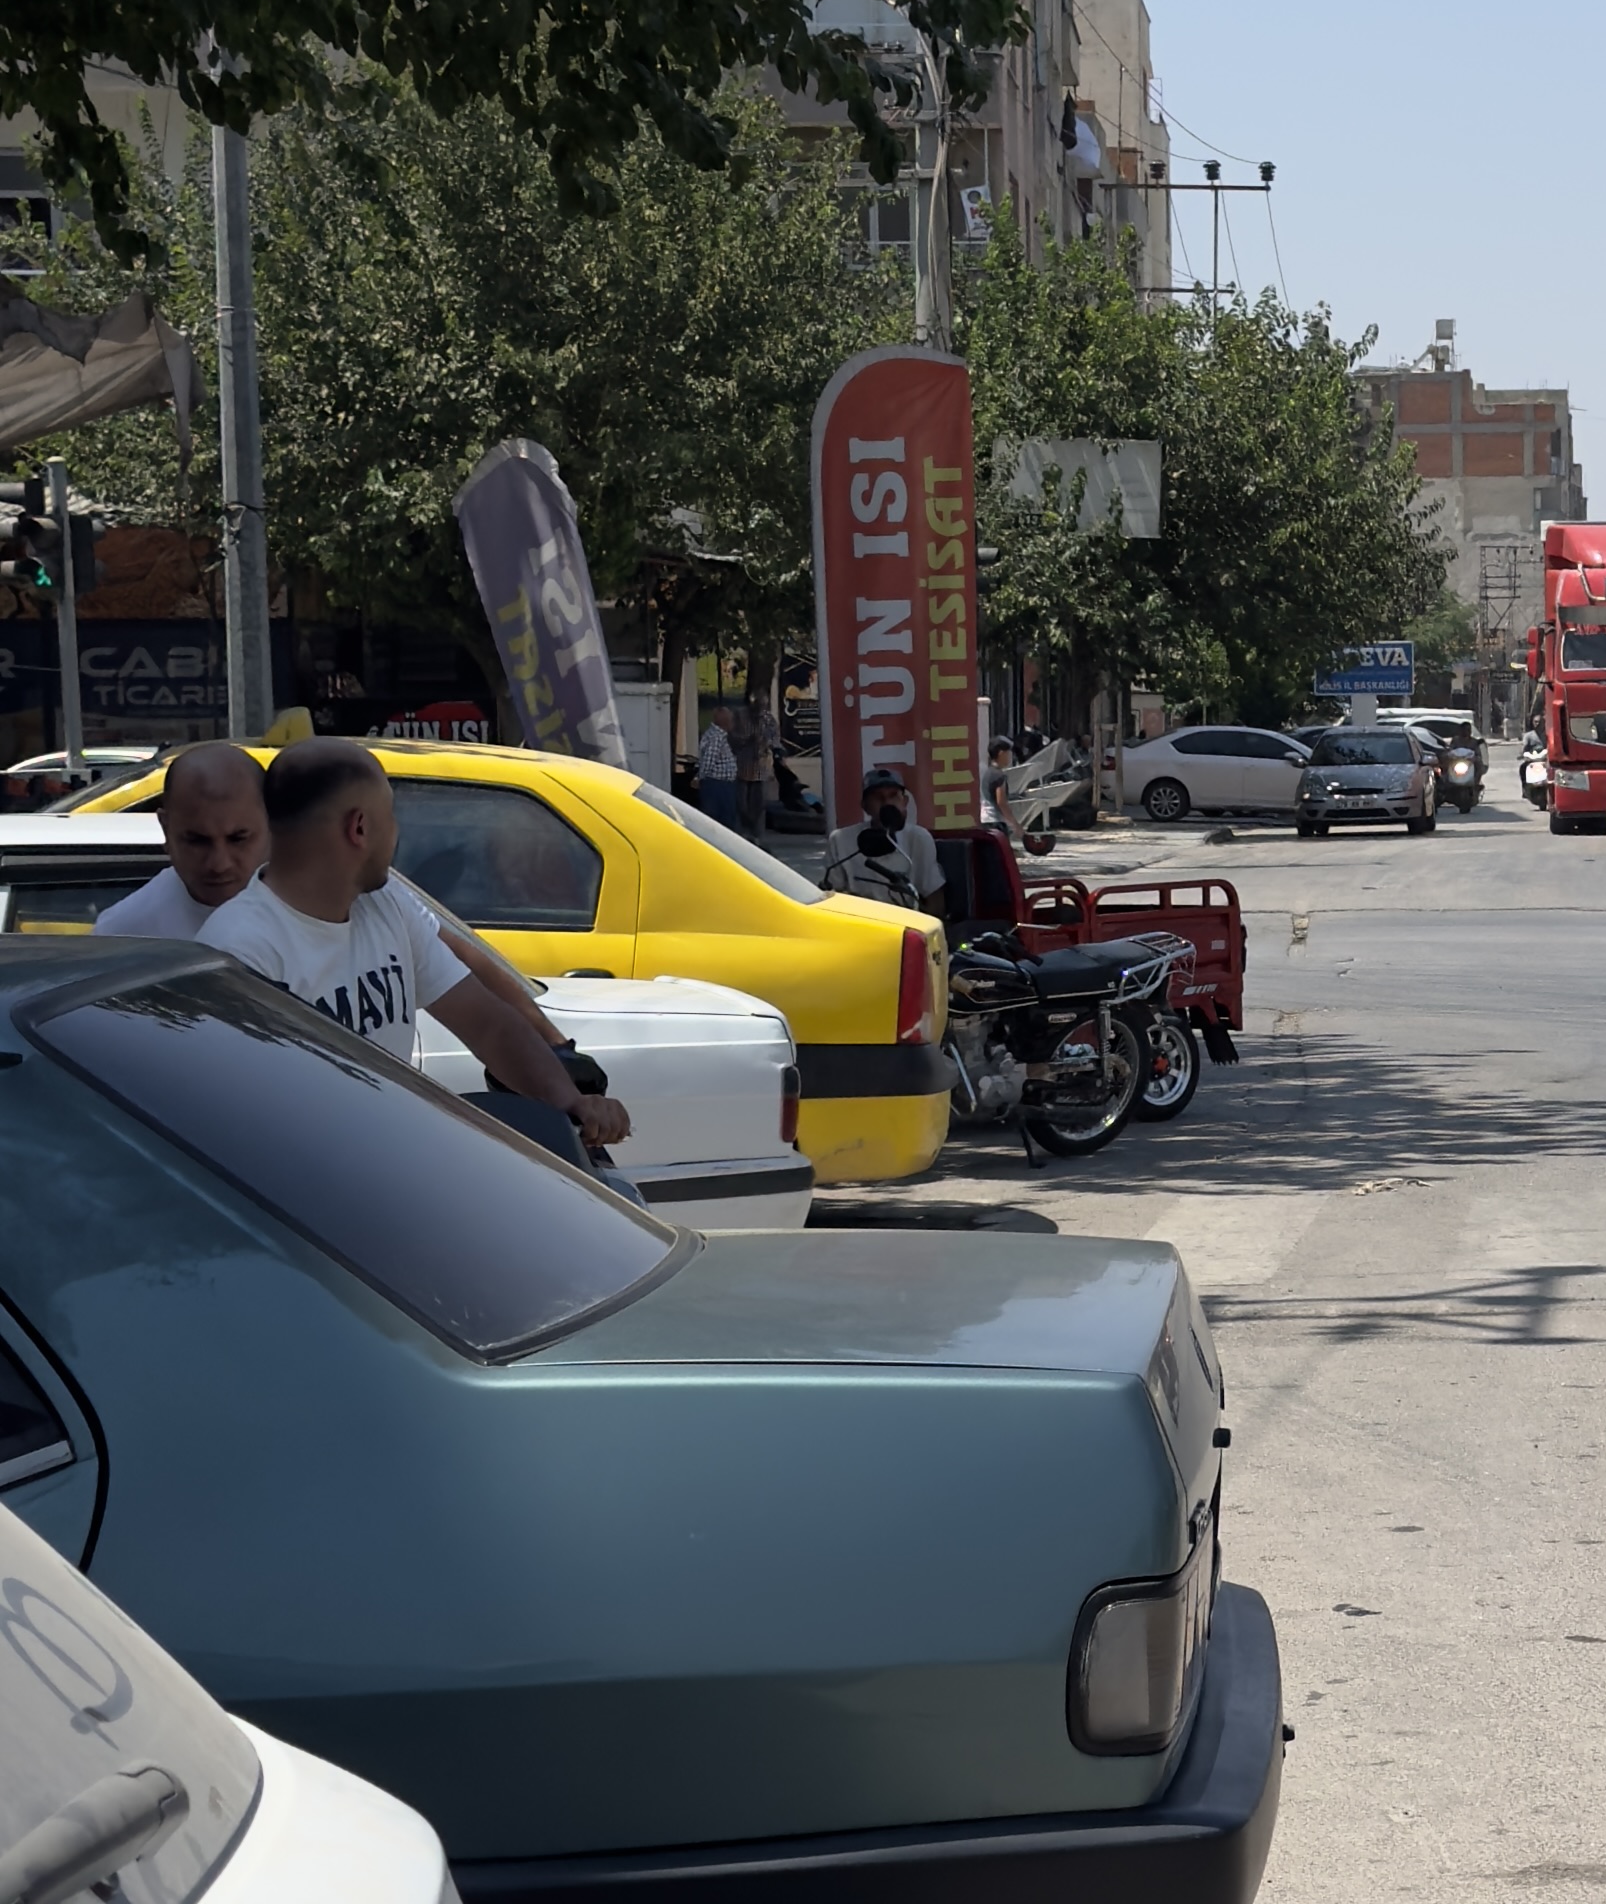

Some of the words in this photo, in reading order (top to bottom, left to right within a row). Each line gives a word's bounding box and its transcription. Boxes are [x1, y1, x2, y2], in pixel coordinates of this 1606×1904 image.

[848, 436, 909, 558] ISI
[918, 455, 969, 702] TESİSAT
[93, 674, 229, 706] TİCARE
[843, 597, 917, 824] TÜN
[1343, 647, 1410, 666] EVA
[922, 724, 976, 831] HHİ
